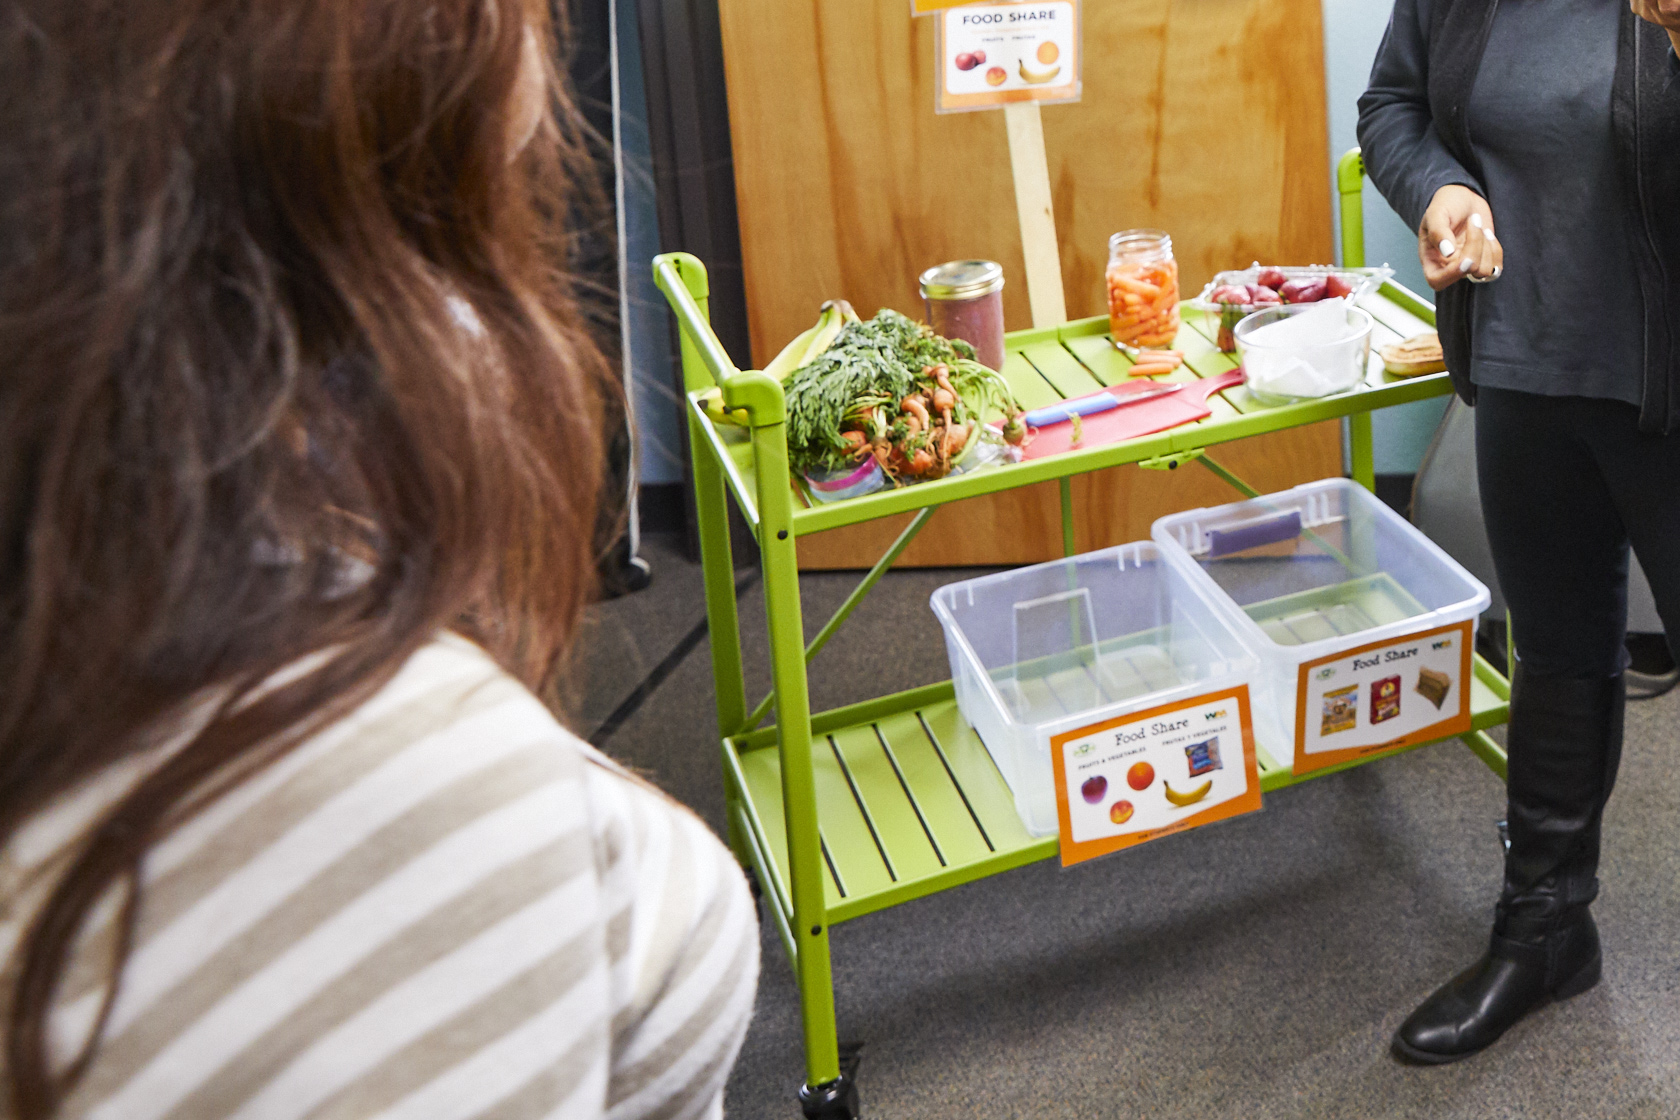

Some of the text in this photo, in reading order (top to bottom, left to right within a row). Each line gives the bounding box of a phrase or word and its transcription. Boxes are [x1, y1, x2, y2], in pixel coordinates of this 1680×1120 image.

[962, 10, 1057, 25] FOOD SHARE
[1352, 647, 1419, 671] Food Share
[1115, 718, 1189, 746] Food Share
